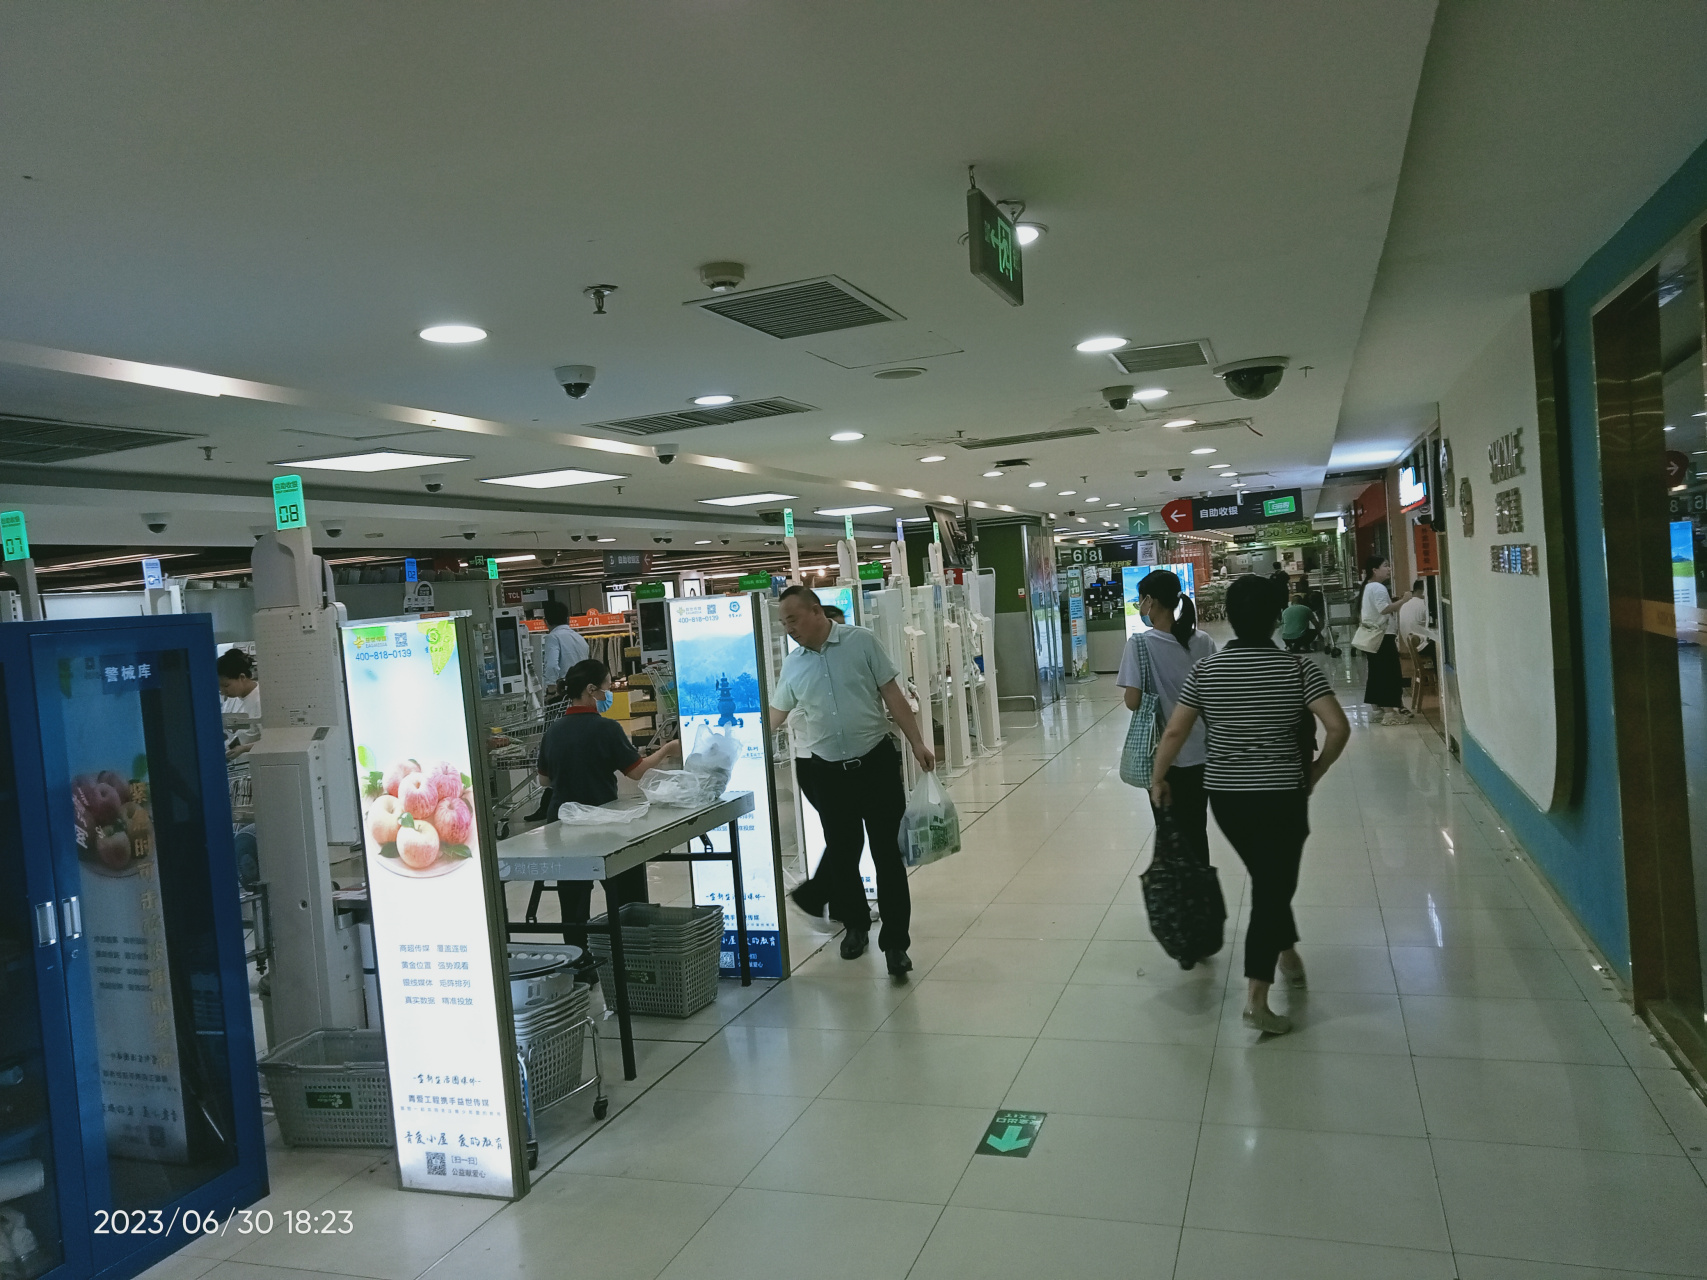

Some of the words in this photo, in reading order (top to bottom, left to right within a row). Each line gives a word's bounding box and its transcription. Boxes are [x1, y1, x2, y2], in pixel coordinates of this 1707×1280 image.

[279, 504, 299, 523] 08
[1199, 506, 1239, 519] 自助收银
[6, 537, 23, 555] 07
[356, 648, 412, 661] 400-818-0139
[104, 663, 152, 683] 警械库
[513, 862, 563, 876] 微信支付
[399, 944, 430, 953] 商超传媒
[437, 944, 468, 953] 覆盖连锁
[401, 960, 432, 970] 黄金位置
[437, 961, 469, 970] 强势观看
[439, 979, 471, 988] 矩阵排列
[405, 995, 436, 1005] 真实数据
[441, 996, 474, 1006] 精准投放
[408, 1094, 490, 1107] 青爱工程携手益世传媒
[404, 1130, 449, 1147] 青爱小屋
[451, 1167, 487, 1179] 公益献爱心
